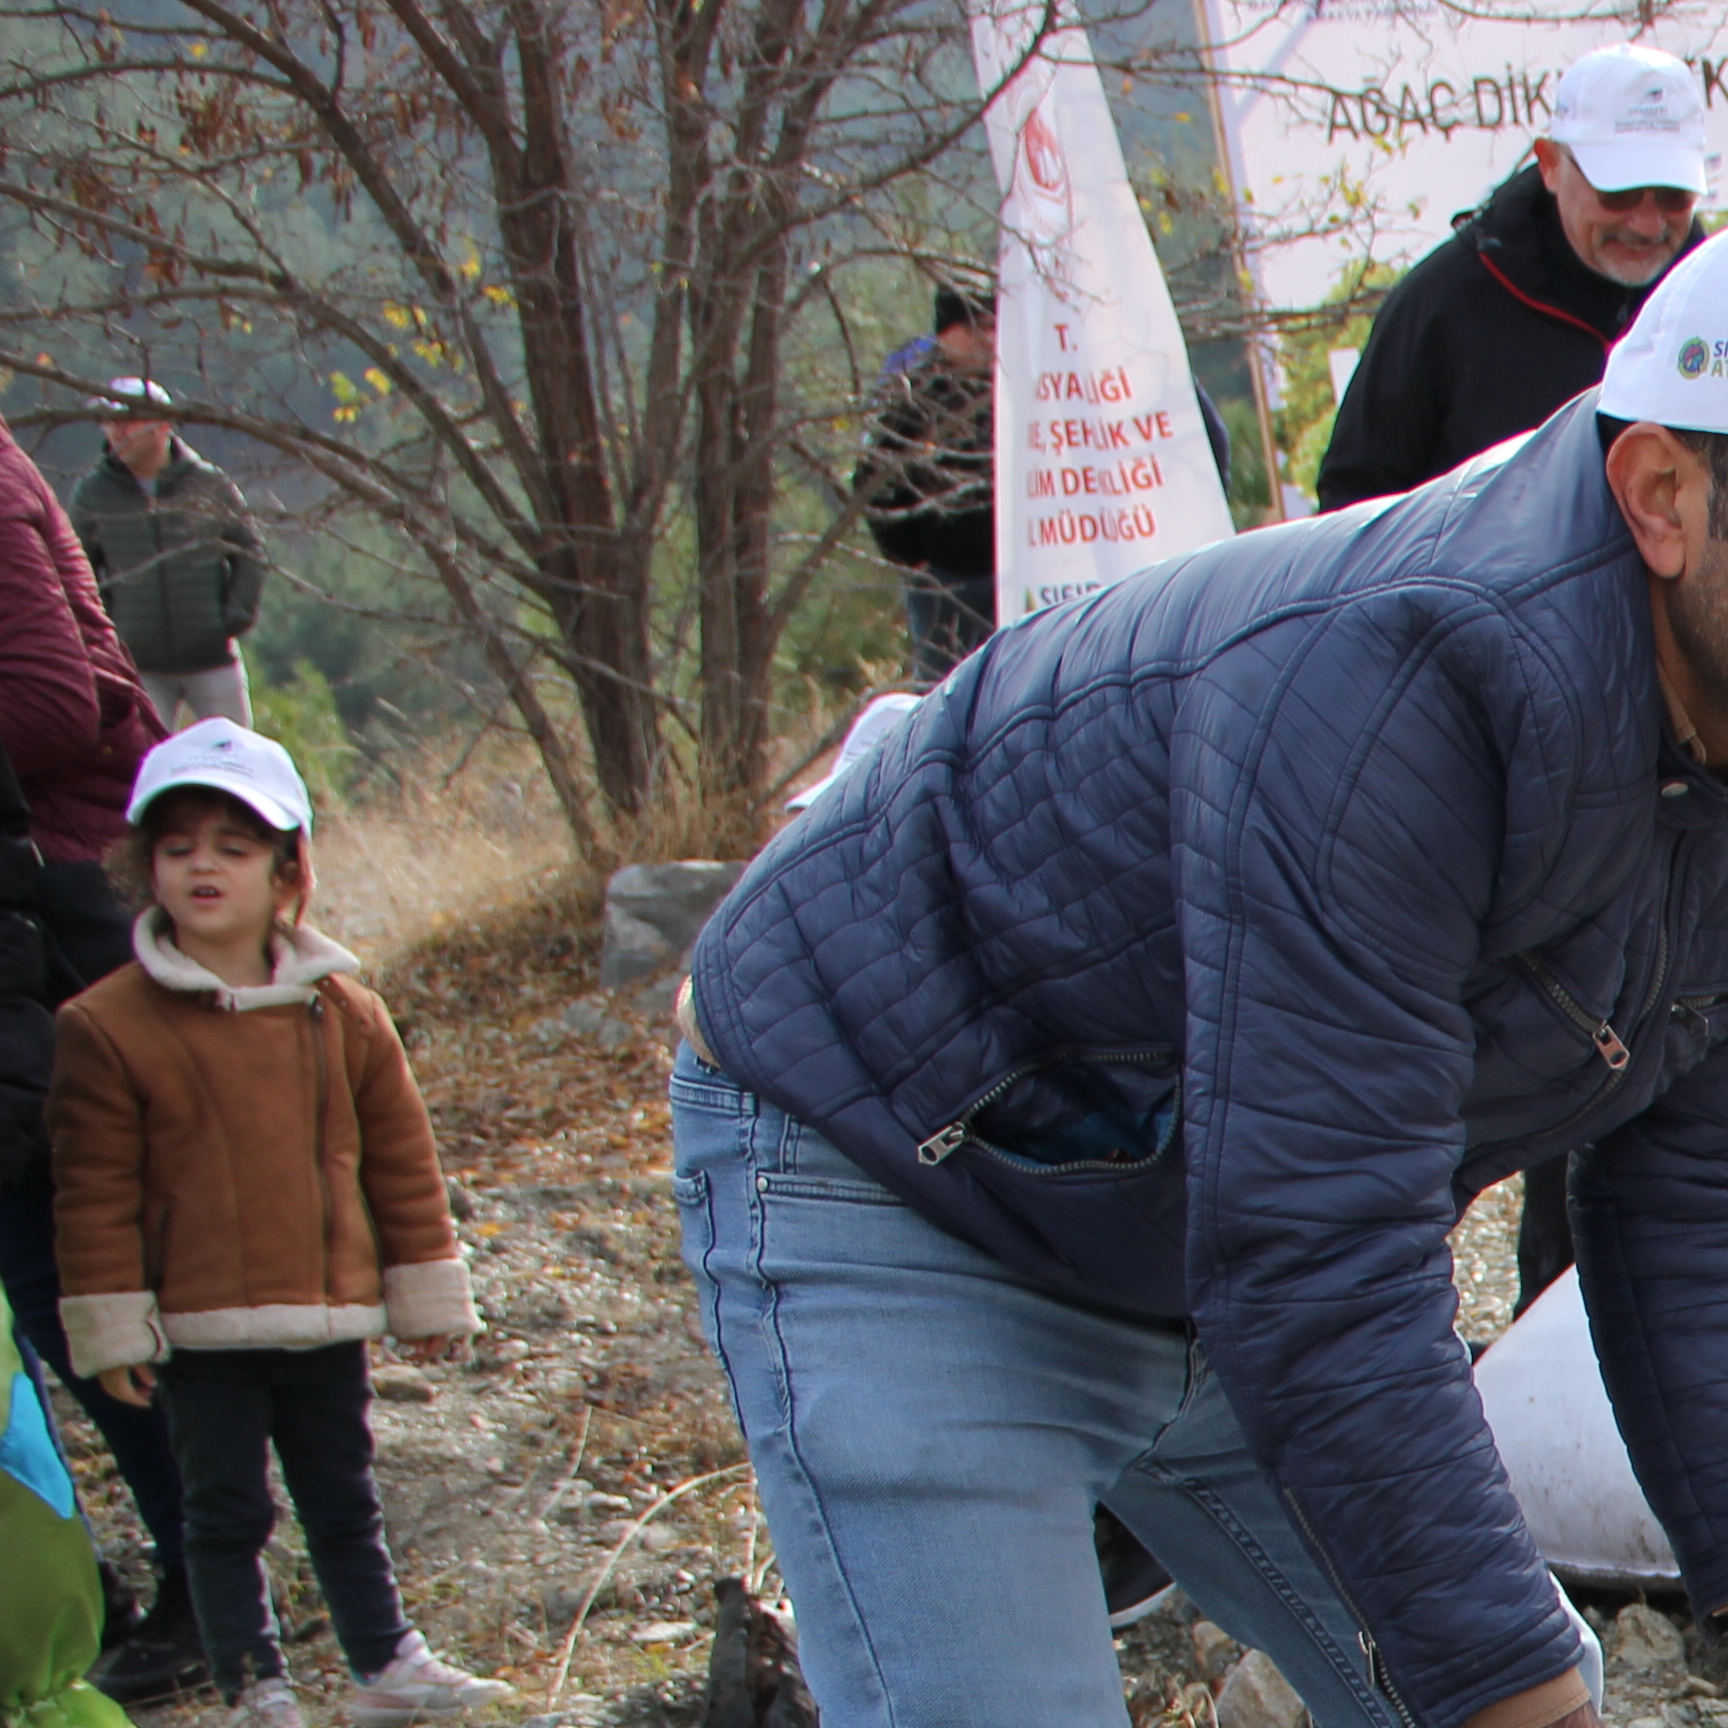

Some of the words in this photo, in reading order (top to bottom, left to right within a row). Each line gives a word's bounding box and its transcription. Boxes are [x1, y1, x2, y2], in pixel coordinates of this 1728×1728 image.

[1327, 75, 1456, 143] AĞAÇ
[1474, 63, 1563, 130] DİK
[1133, 411, 1174, 442] VE
